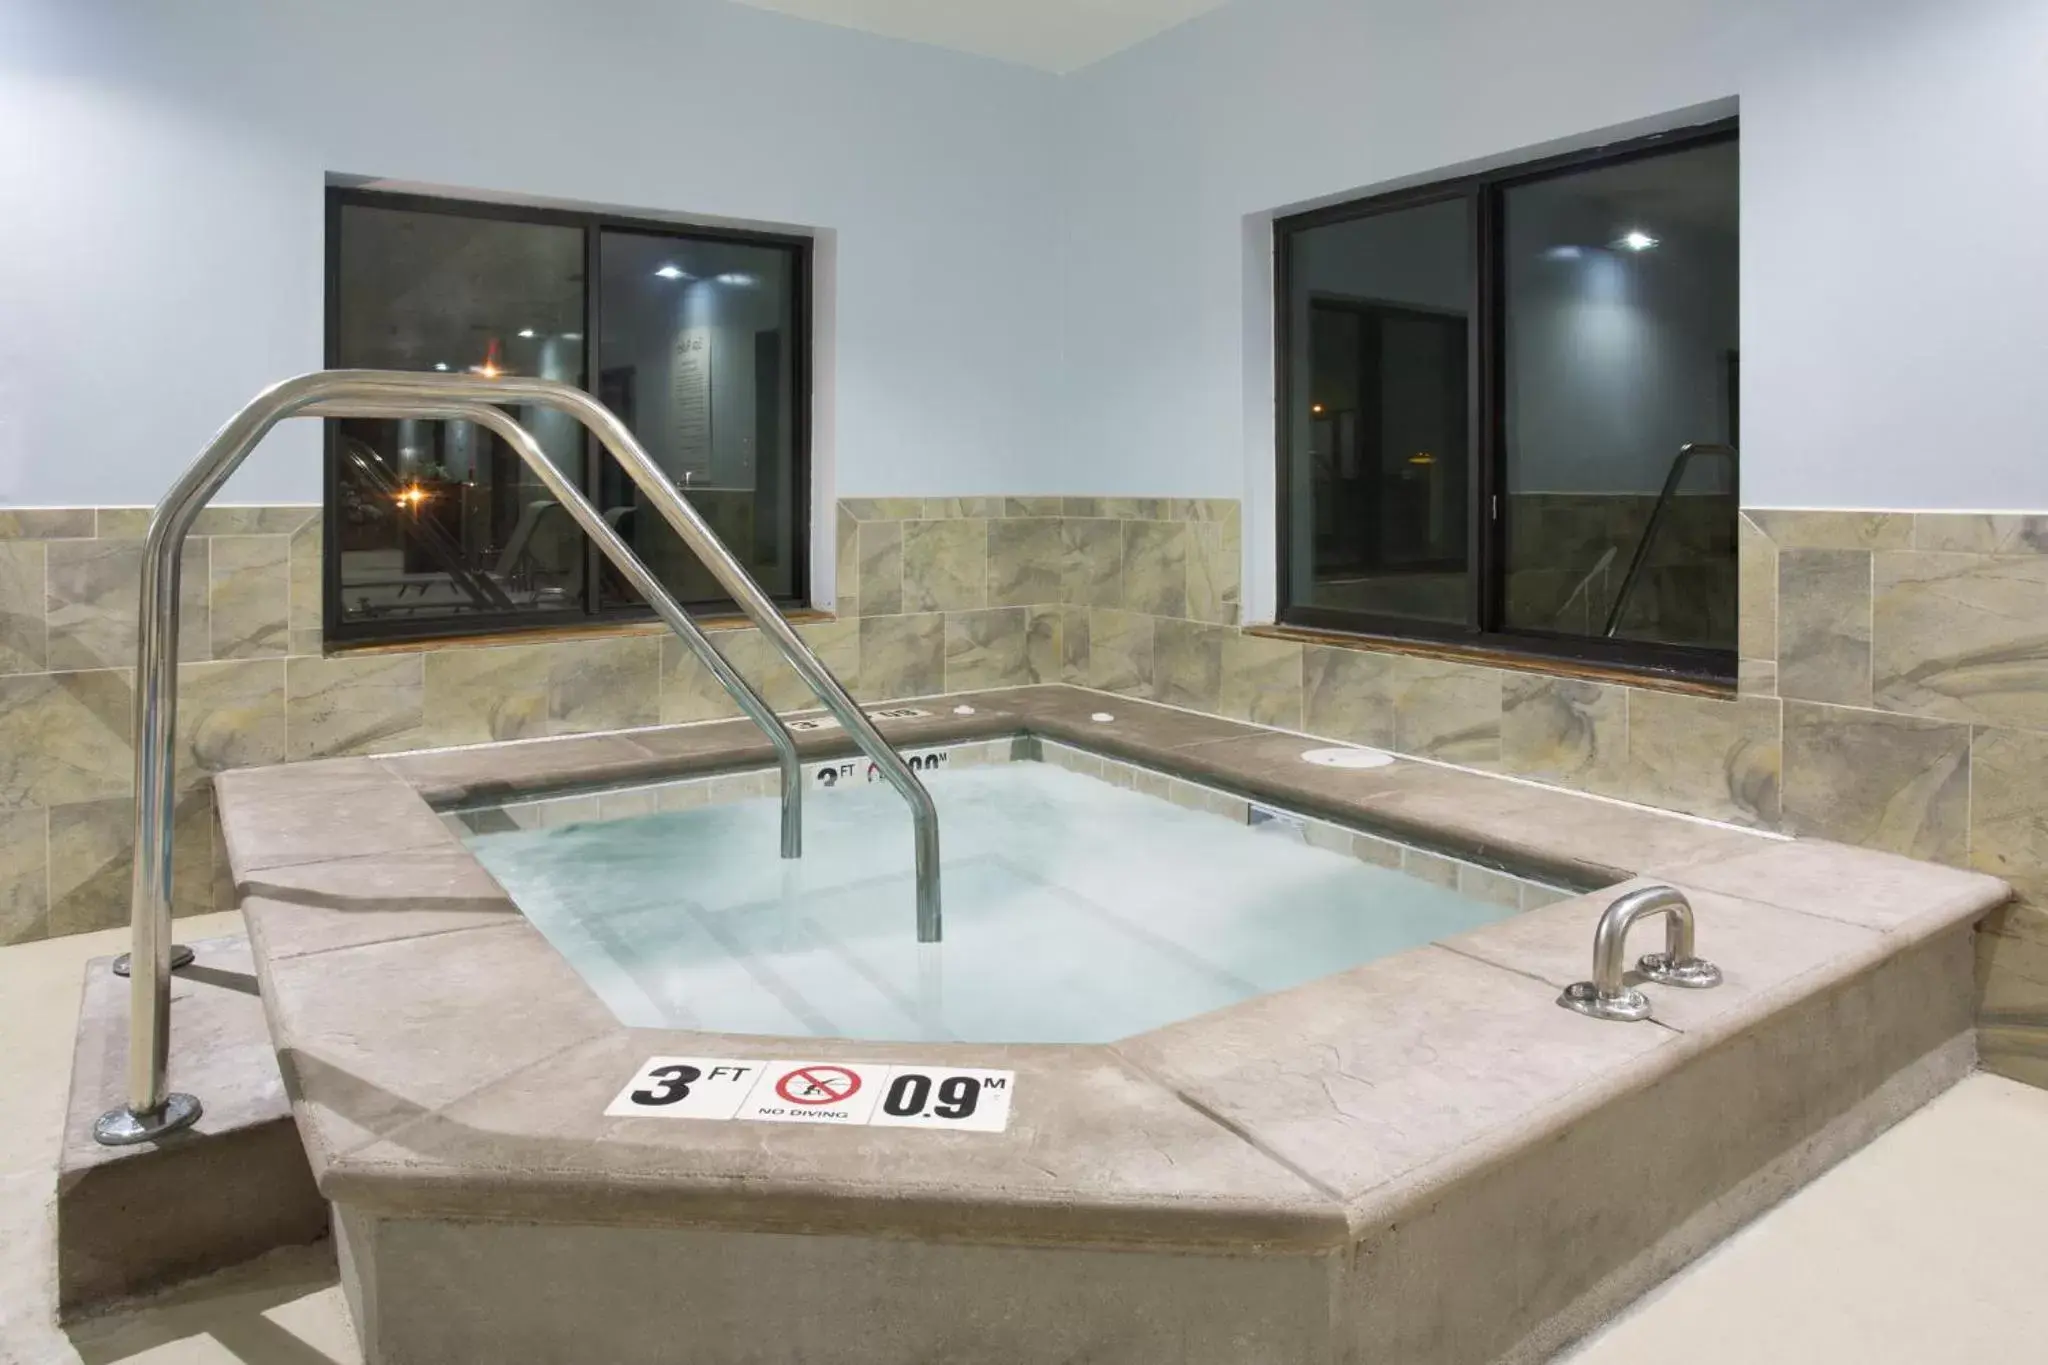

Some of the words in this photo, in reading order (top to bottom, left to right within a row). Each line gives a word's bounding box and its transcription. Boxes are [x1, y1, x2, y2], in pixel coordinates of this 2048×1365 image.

[841, 763, 856, 777] FT
[631, 1065, 702, 1106] 3
[707, 1066, 753, 1082] FT
[883, 1073, 981, 1119] 0.9
[983, 1077, 1007, 1089] M
[758, 1107, 785, 1116] NO
[789, 1109, 849, 1118] DIVING
